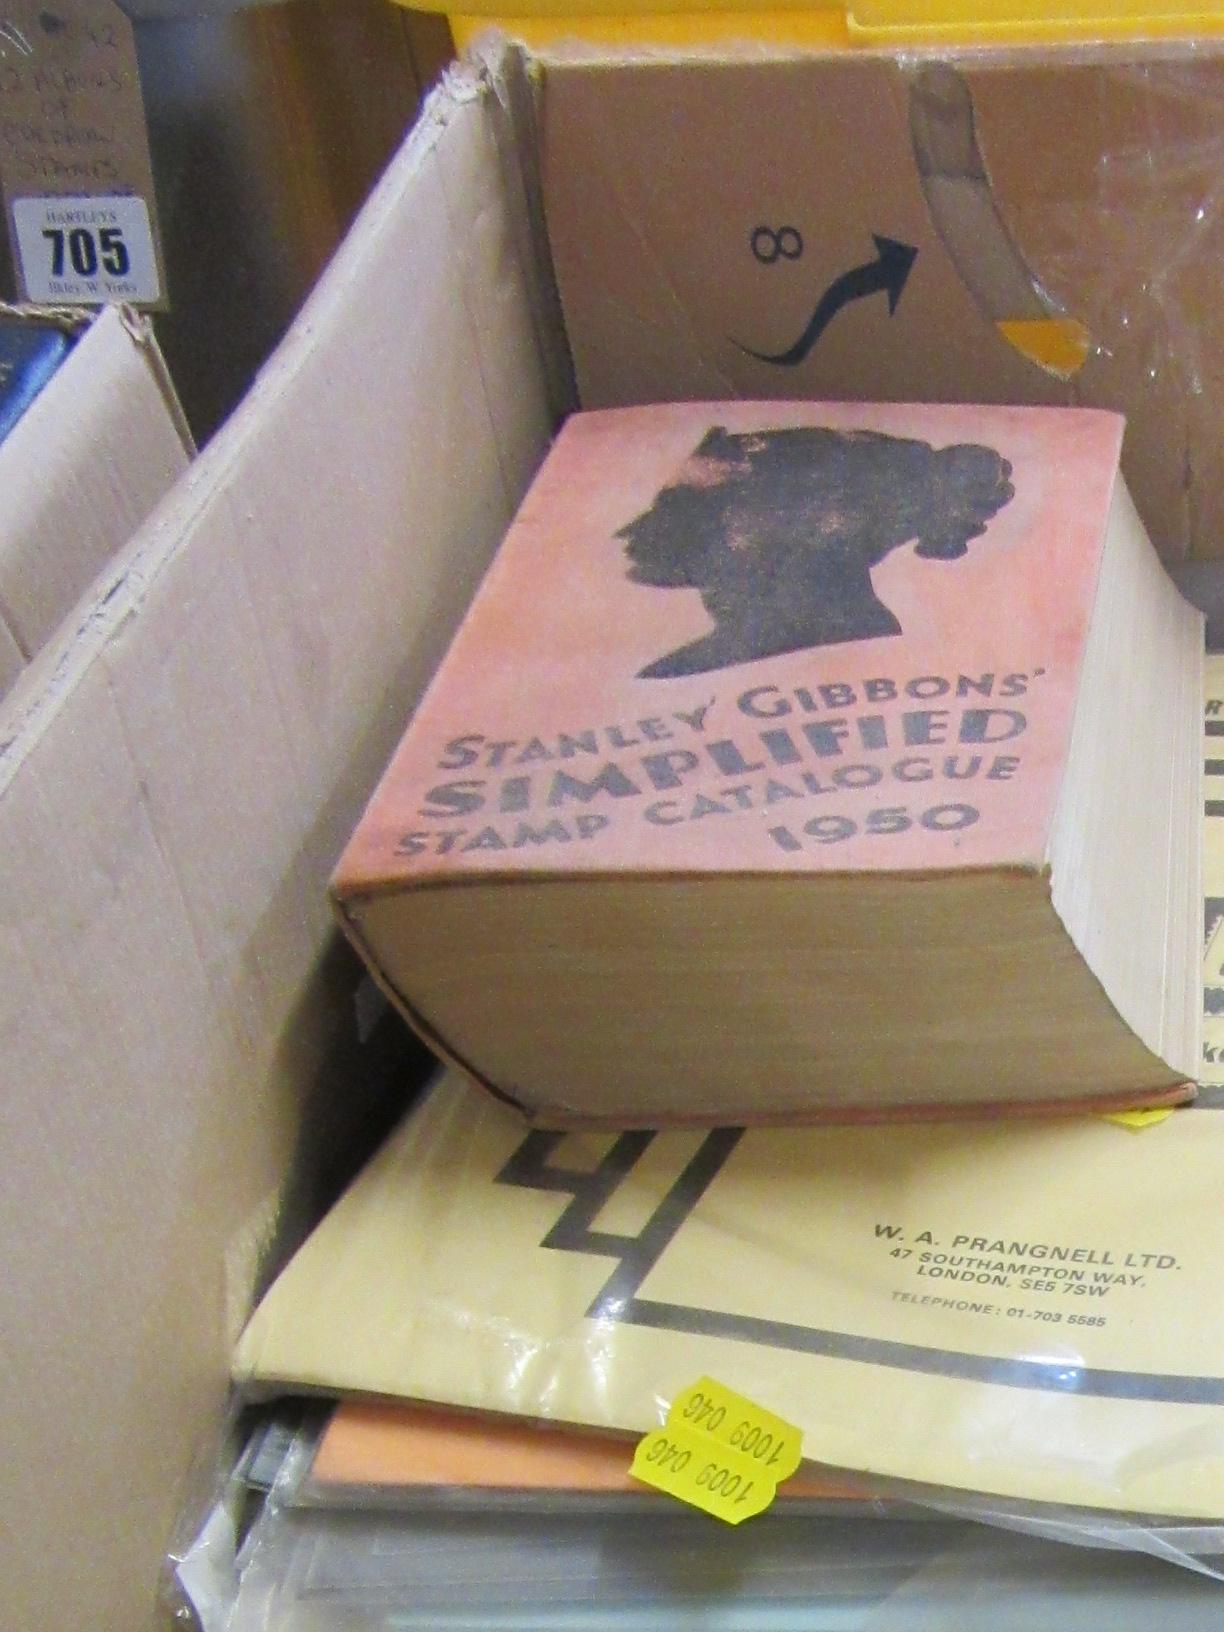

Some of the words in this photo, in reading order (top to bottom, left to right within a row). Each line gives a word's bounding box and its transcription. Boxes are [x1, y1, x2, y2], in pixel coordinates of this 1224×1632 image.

[42, 228, 130, 277] 705
[750, 224, 803, 265] 8
[438, 696, 715, 770] STANLEY
[417, 709, 1029, 819] SIMPLIFIED
[395, 814, 611, 857] STAMP
[644, 755, 1021, 827] CATALOGUE
[767, 803, 980, 852] 1950
[874, 1224, 905, 1242] W.
[915, 1230, 940, 1247] A.
[952, 1234, 1115, 1267] PRANGNELL
[1124, 1252, 1183, 1271] LTD.
[889, 1247, 913, 1261] 47
[919, 1250, 1085, 1283] SOUTHAMPTON
[891, 1290, 1003, 1317] TELEPHONE:
[1020, 1277, 1055, 1293] SE5
[1062, 1281, 1111, 1298] 7SW
[729, 1420, 786, 1467] 1009
[695, 1462, 755, 1505] 1009
